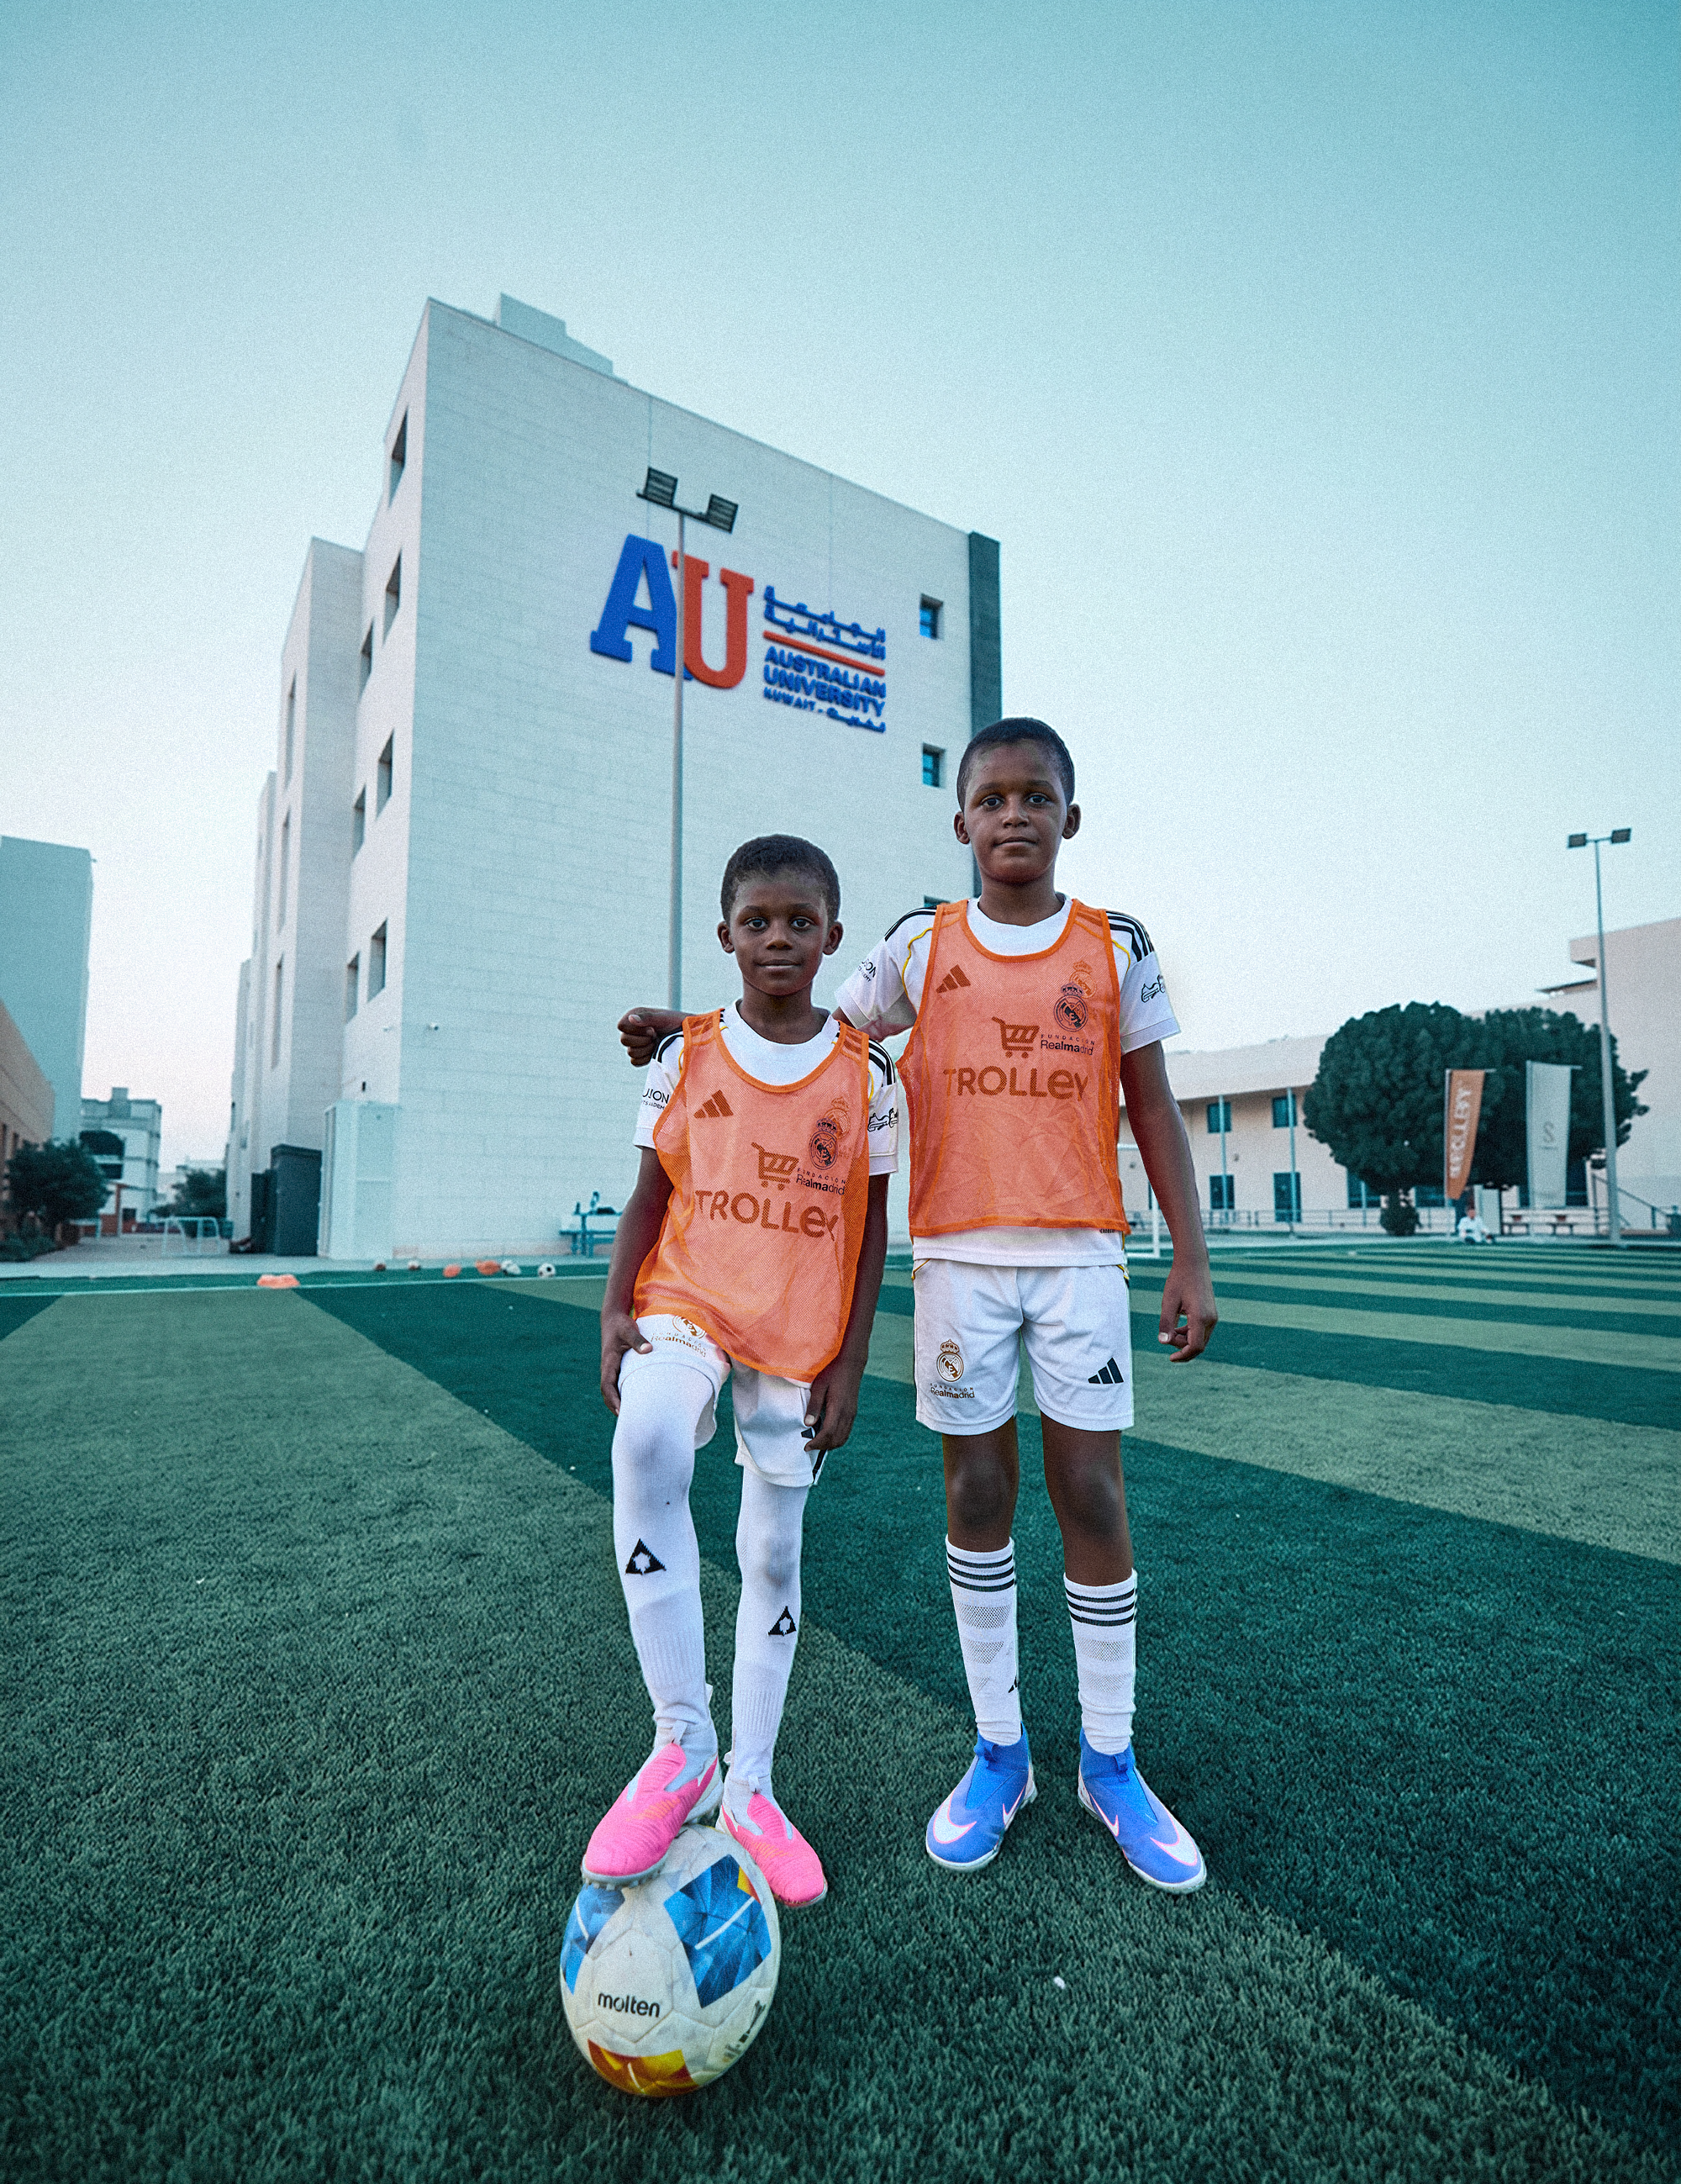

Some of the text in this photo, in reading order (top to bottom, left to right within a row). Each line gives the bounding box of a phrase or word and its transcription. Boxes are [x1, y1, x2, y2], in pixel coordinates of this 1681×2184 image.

[591, 534, 754, 689] AU
[763, 664, 885, 717] UNIVERSITY
[763, 686, 816, 711] KUWAIT
[765, 646, 886, 699] AUSTRALIAN
[598, 1992, 661, 2018] molten
